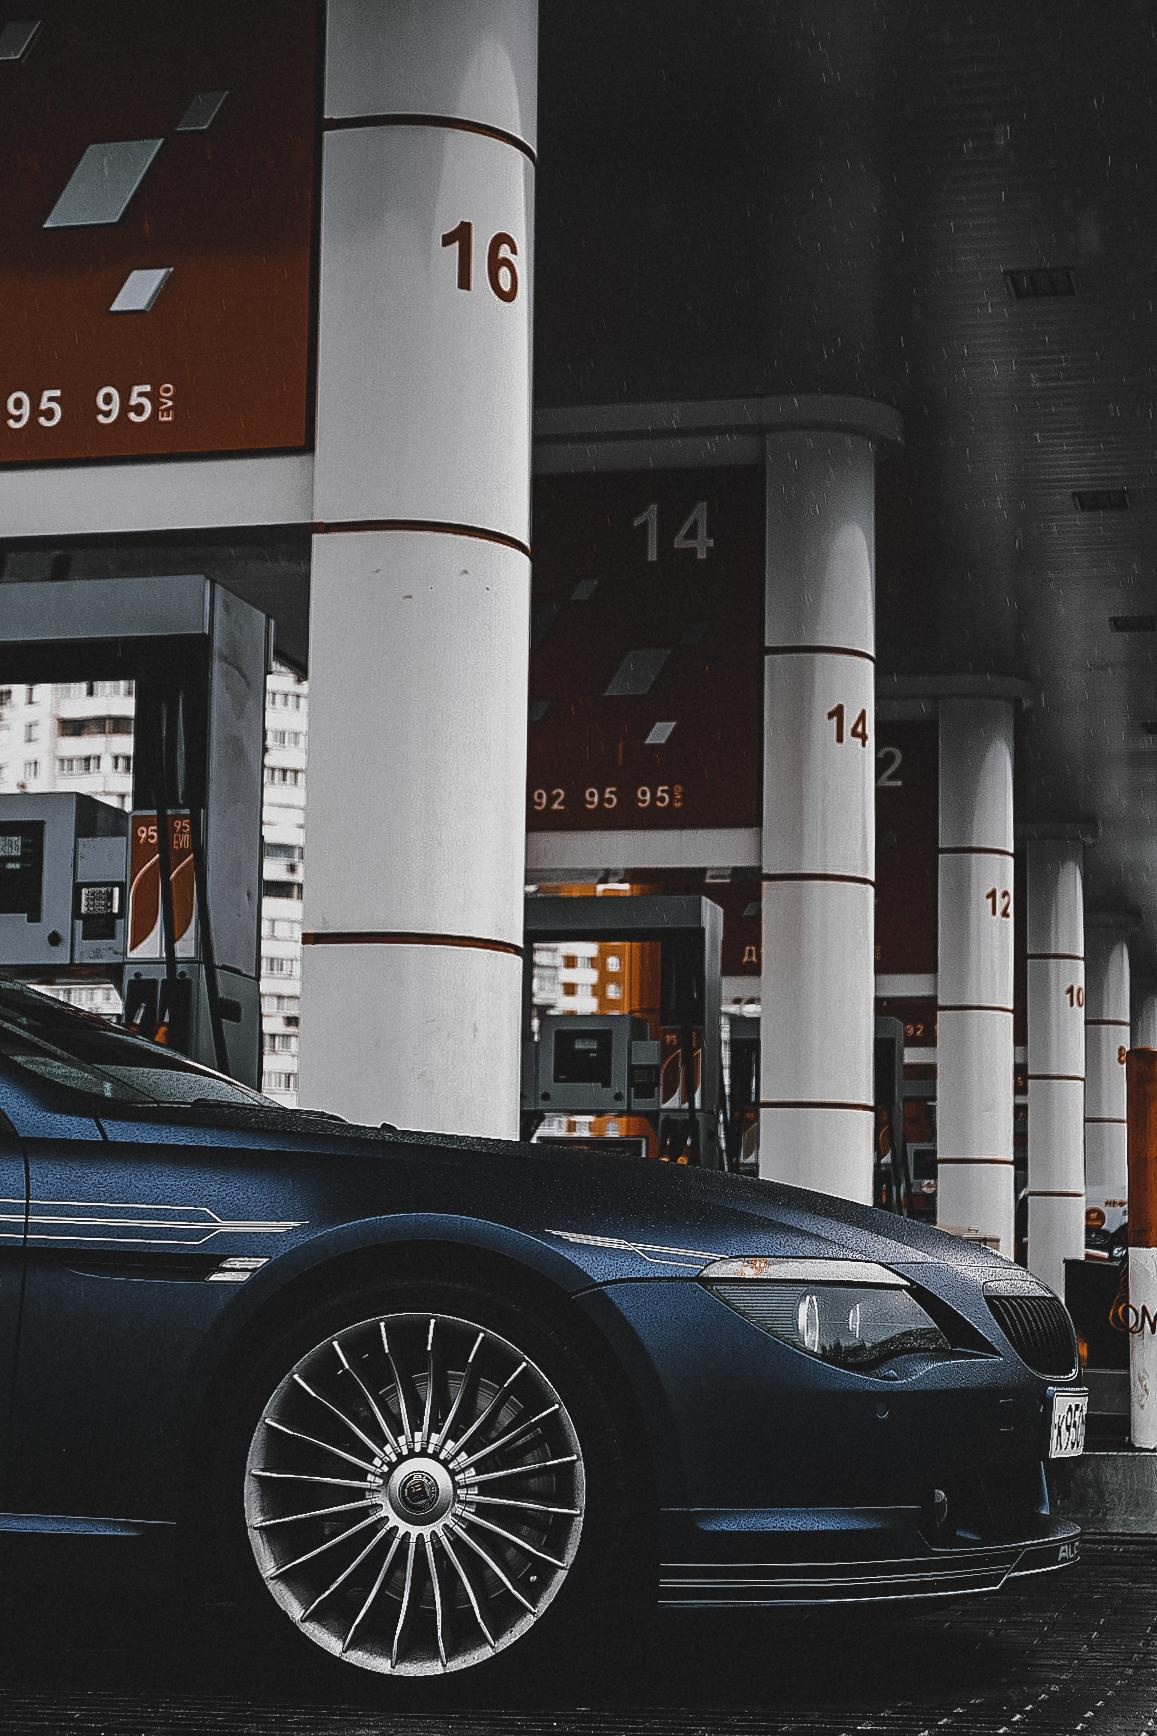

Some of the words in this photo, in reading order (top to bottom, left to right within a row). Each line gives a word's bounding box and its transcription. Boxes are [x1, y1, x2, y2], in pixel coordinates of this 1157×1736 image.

[441, 220, 519, 302] 16
[6, 390, 62, 428] 95
[96, 385, 152, 423] 95
[159, 383, 174, 422] EVO
[633, 502, 714, 560] 14
[827, 704, 869, 748] 14
[533, 788, 565, 810] 92
[584, 787, 618, 810] 95
[637, 785, 670, 809] 95
[136, 826, 158, 844] 95
[174, 819, 190, 833] 95
[985, 888, 1011, 918] 12
[1064, 984, 1084, 1007] 10
